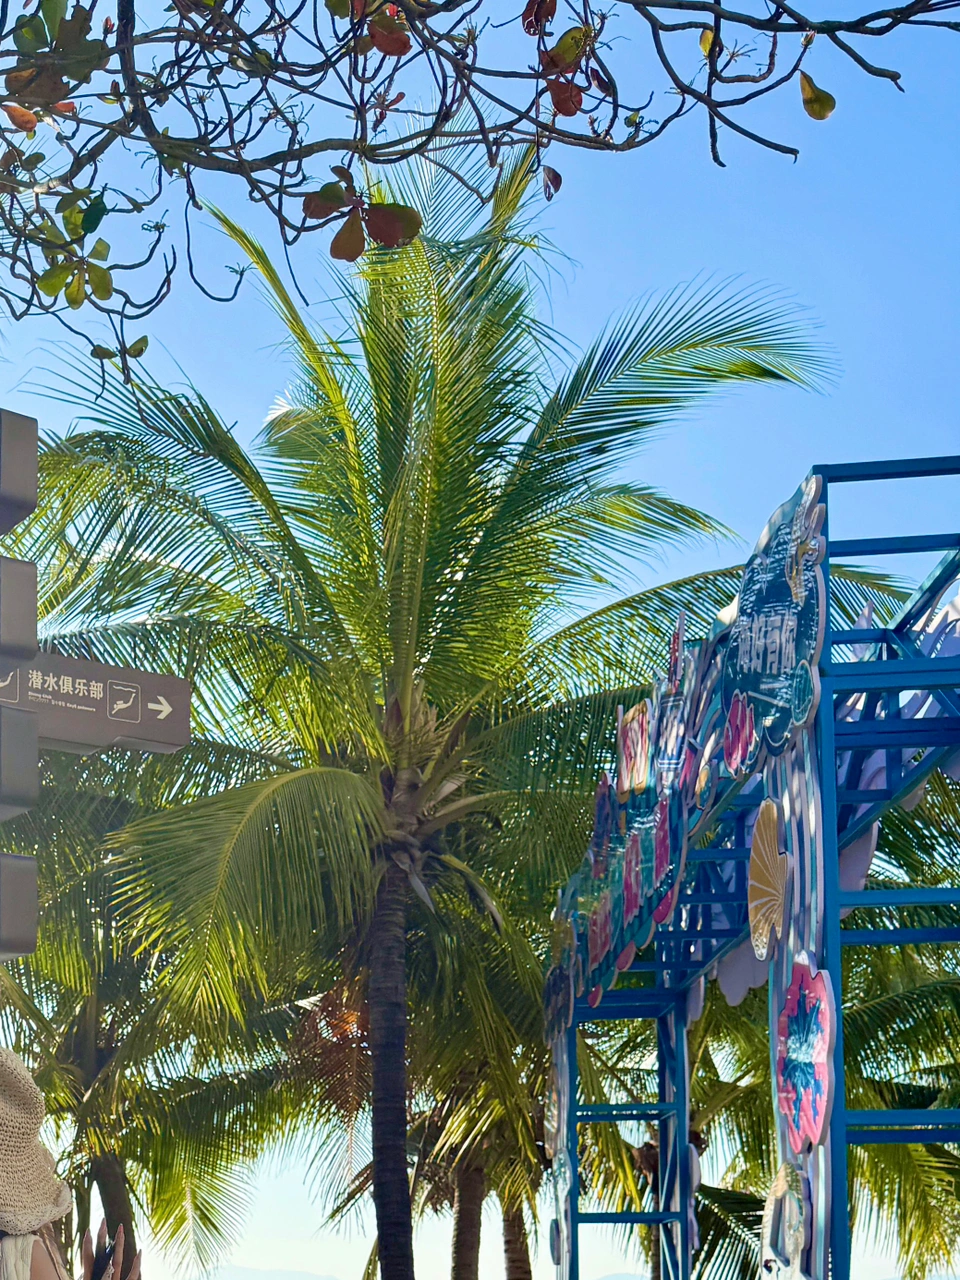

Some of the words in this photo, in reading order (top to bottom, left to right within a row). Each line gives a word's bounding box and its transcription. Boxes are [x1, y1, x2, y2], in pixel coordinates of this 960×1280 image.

[28, 669, 104, 700] 潜水俱乐部
